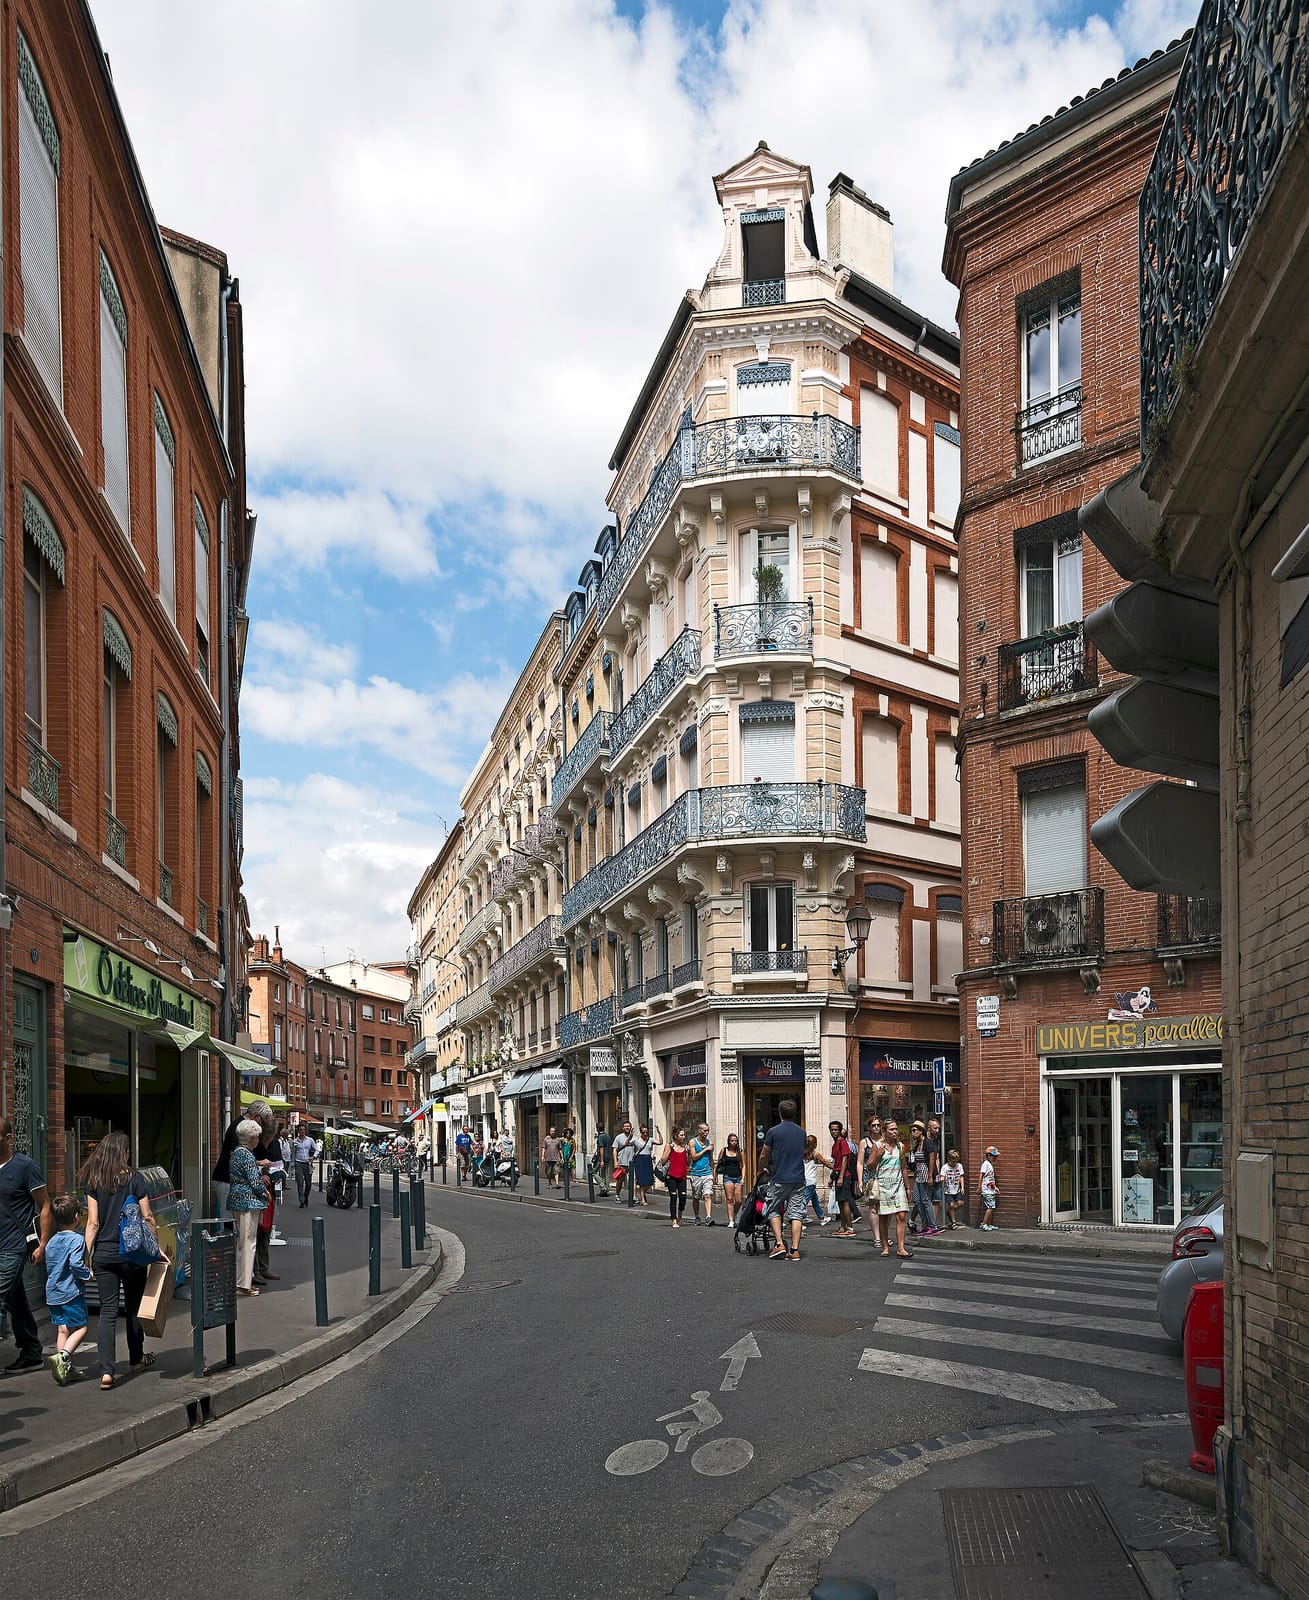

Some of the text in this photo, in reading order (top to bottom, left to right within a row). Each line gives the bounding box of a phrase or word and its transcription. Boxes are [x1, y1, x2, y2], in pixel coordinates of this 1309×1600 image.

[1039, 1022, 1137, 1050] UNIVERS
[761, 1057, 792, 1070] TERRES
[884, 1053, 911, 1071] TERRES
[911, 1061, 920, 1071] DE
